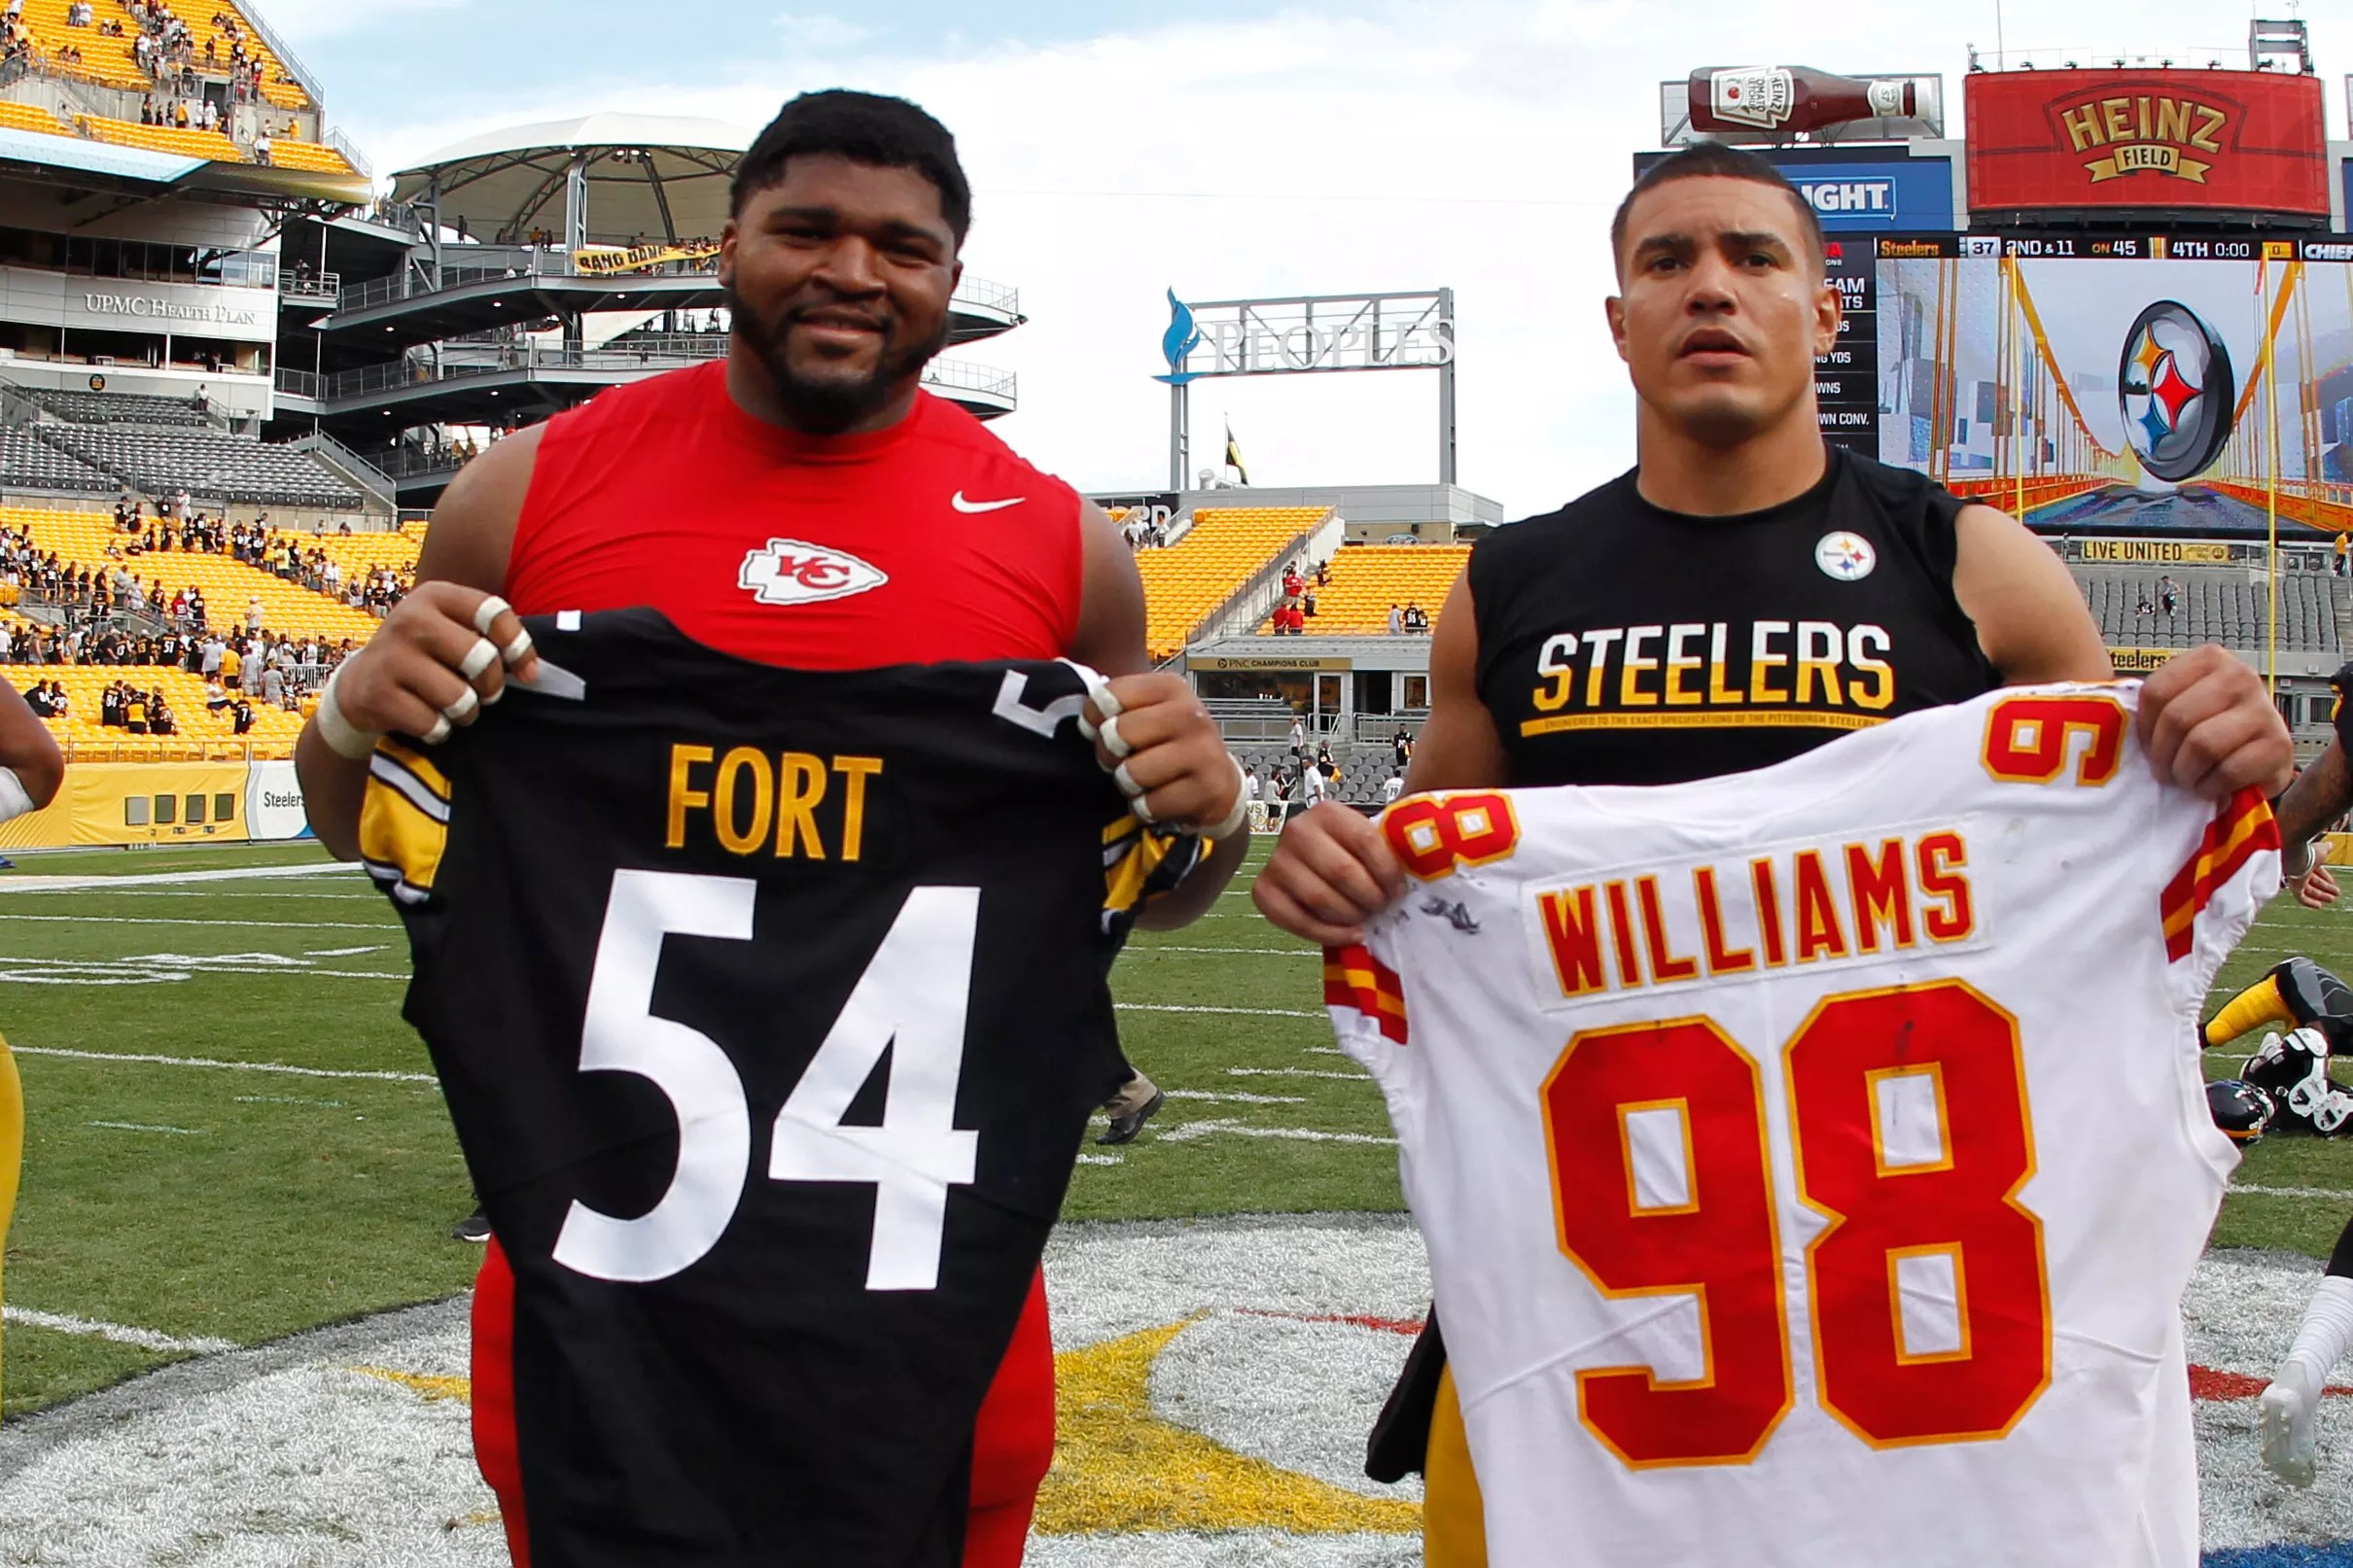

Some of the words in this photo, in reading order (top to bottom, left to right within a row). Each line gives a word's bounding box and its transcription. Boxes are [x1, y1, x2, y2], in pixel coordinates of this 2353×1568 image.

[2061, 96, 2227, 154] HEINZ
[2123, 150, 2171, 166] FIELD
[1880, 240, 1940, 256] Steelers
[1972, 241, 1994, 255] 37
[2006, 240, 2042, 256] 2ND
[2056, 240, 2076, 256] 11
[2091, 244, 2110, 254] ON
[2112, 240, 2137, 256] 45
[2172, 241, 2208, 257] 4TH
[2215, 242, 2250, 257] 0:00
[579, 254, 625, 270] BANG
[1823, 277, 1866, 294] EAM
[85, 293, 146, 316] UPMC
[1211, 318, 1456, 373] PEOPLES
[1830, 351, 1851, 364] YDS
[1815, 382, 1842, 394] WNS
[1818, 413, 1836, 425] WN
[2084, 540, 2118, 559] LIVE
[2125, 542, 2182, 561] UNITED
[1532, 620, 1894, 711] STEELERS
[2110, 648, 2166, 669] teelers
[665, 743, 883, 861] FORT
[1535, 829, 1977, 998] WILLIAMS
[552, 869, 982, 1291] 54
[1538, 977, 2054, 1472] 98
